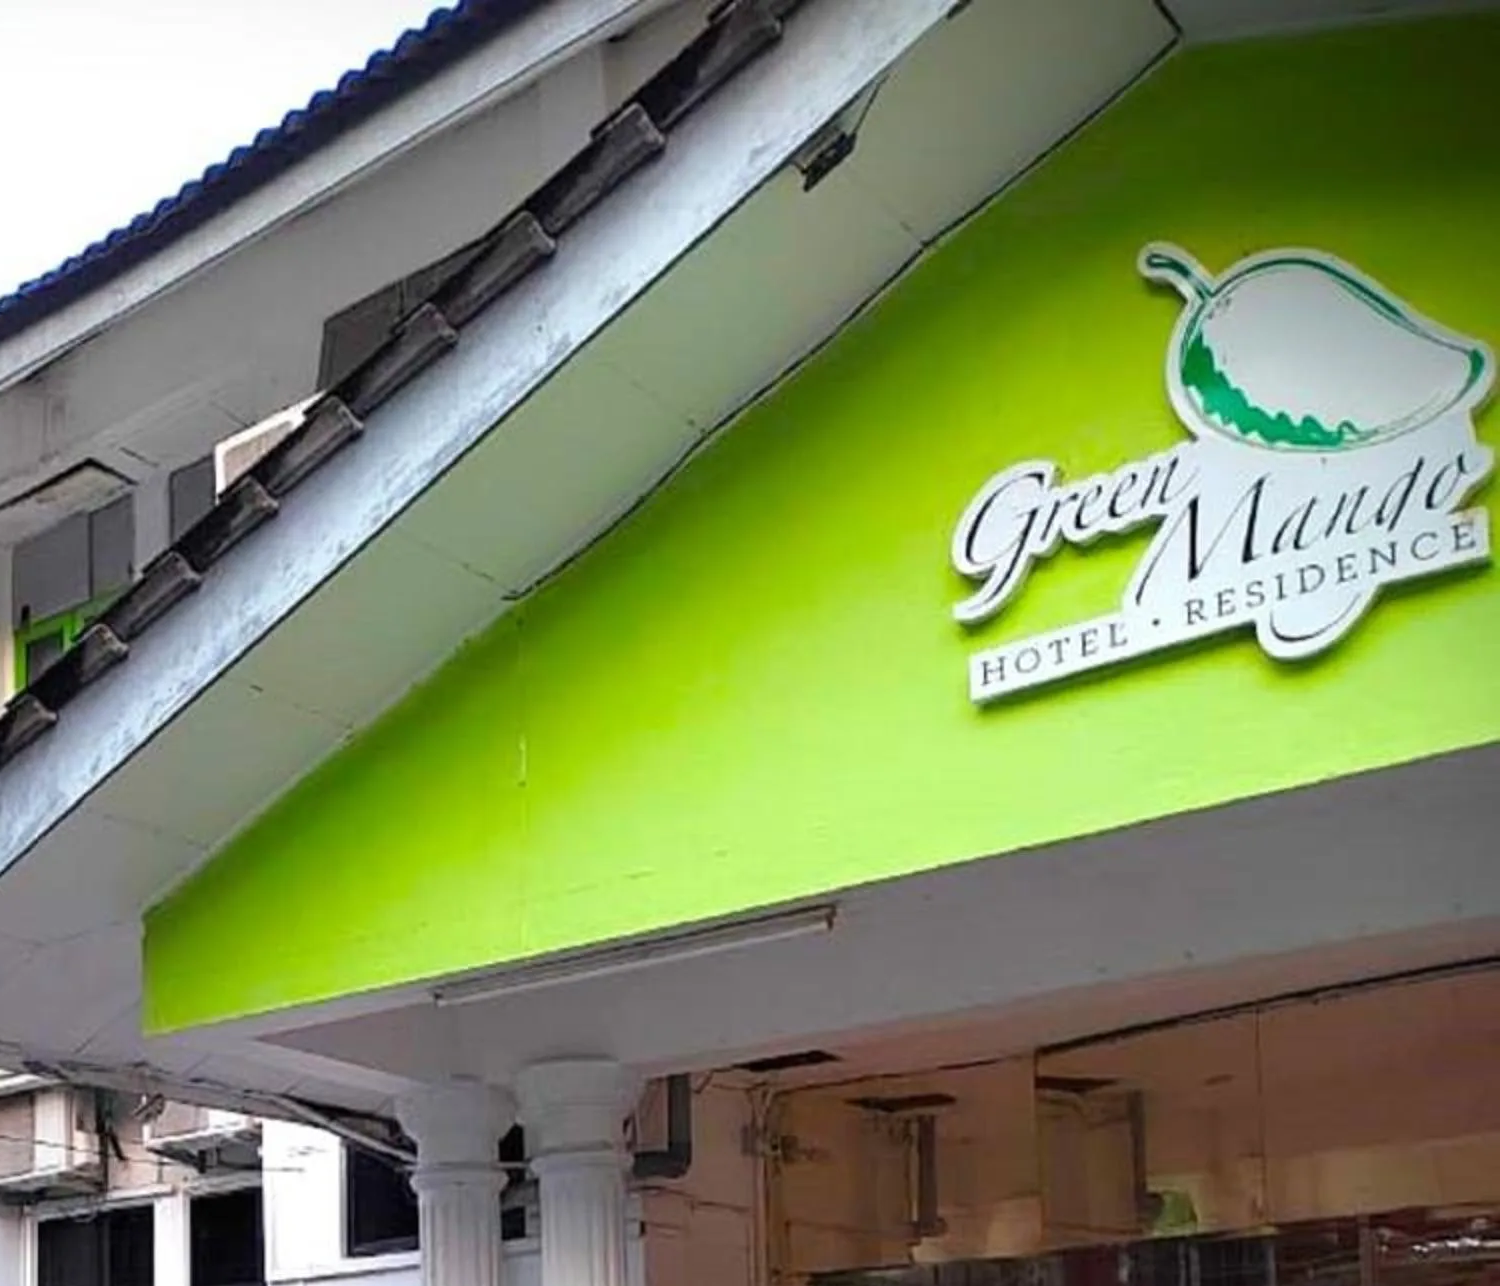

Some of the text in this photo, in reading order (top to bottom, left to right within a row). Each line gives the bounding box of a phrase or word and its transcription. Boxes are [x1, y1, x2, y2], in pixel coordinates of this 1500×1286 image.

[963, 456, 1182, 602] Green
[981, 521, 1478, 686] HOTEL RESIDENCE
[1135, 454, 1471, 643] Mango
